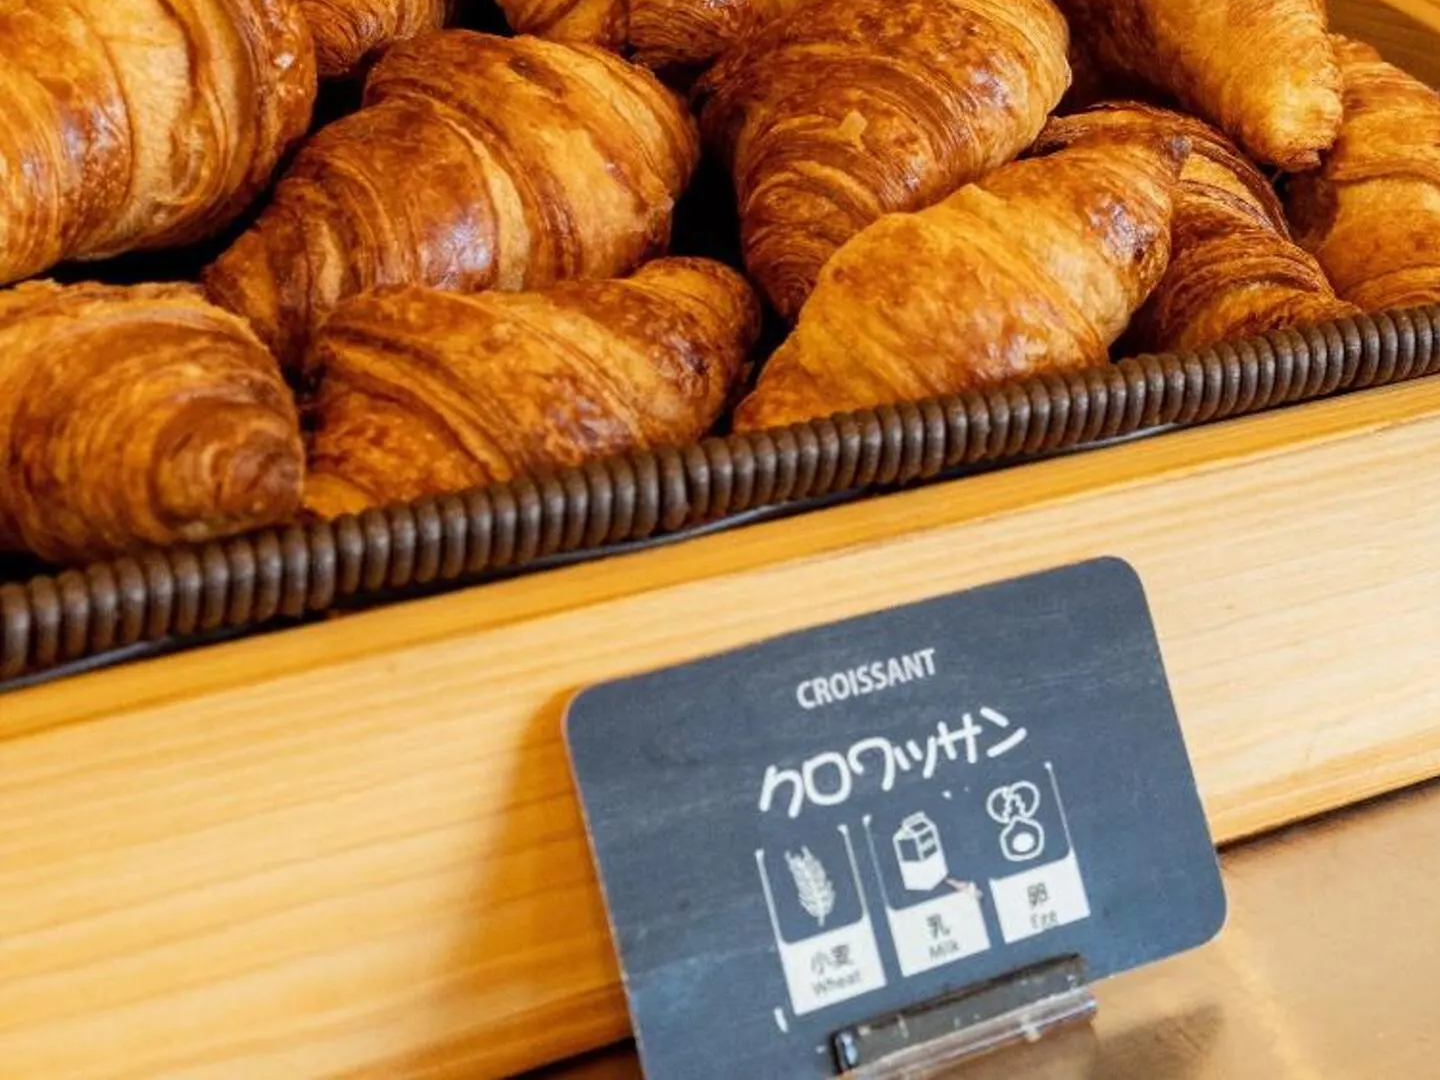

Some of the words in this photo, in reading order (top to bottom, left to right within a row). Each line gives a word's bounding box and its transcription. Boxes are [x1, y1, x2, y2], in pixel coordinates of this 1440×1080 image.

[796, 647, 936, 709] CROISSANT
[759, 706, 1027, 818] クロワッサン
[926, 913, 951, 940] 乳
[810, 944, 854, 975] 小麦
[928, 940, 960, 962] Milk
[811, 970, 861, 997] Wheat
